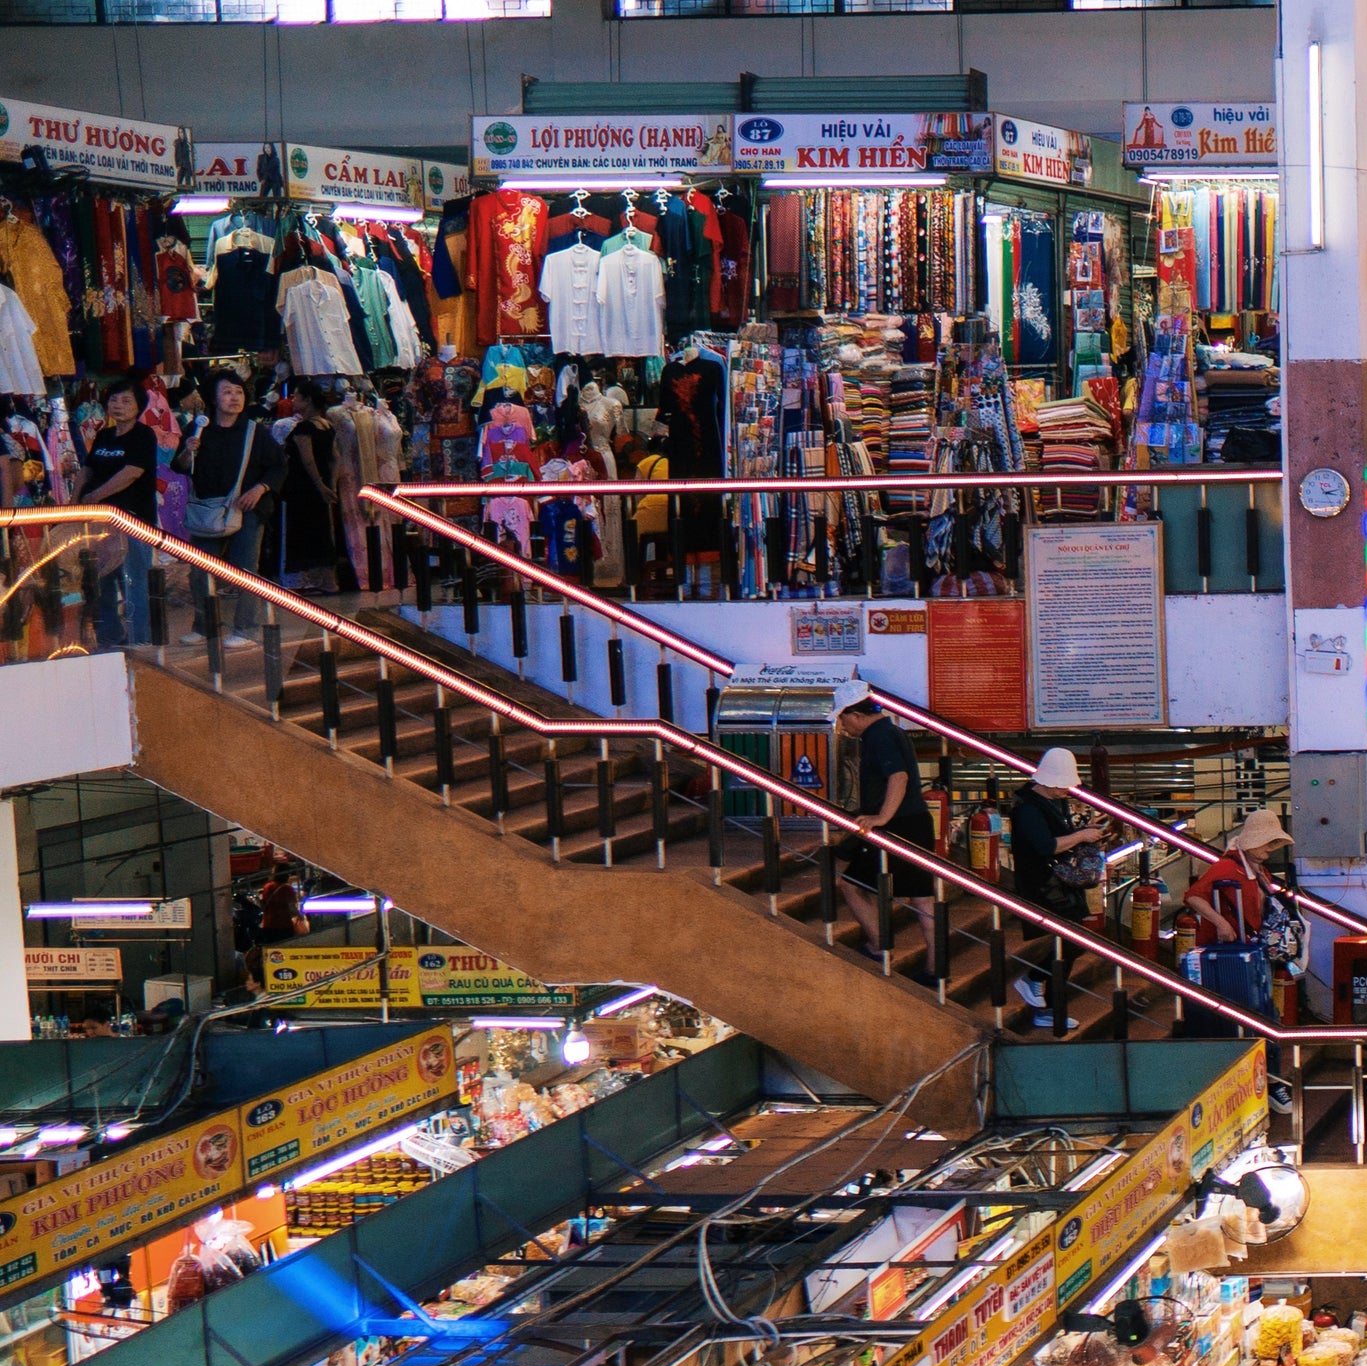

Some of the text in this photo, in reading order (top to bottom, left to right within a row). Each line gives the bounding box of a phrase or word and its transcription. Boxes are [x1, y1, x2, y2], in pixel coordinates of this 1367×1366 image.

[1214, 106, 1269, 127] hiệu vải
[29, 116, 80, 143] THƯ
[85, 126, 166, 157] HƯƠNG
[531, 125, 703, 150] LỢI PHƯỢNG (HẠNH)
[821, 119, 891, 143] HIỆU VẢI
[1198, 128, 1238, 160] Kim
[671, 157, 698, 168] TRANG
[797, 147, 850, 169] KIM
[858, 136, 927, 169] HIỂN
[1129, 148, 1198, 161] 0905478919
[325, 154, 406, 189] CẨM LAI
[449, 979, 472, 989] RAU
[297, 1090, 339, 1126] LỘC
[30, 1160, 187, 1240] KIM PHƯỢNG
